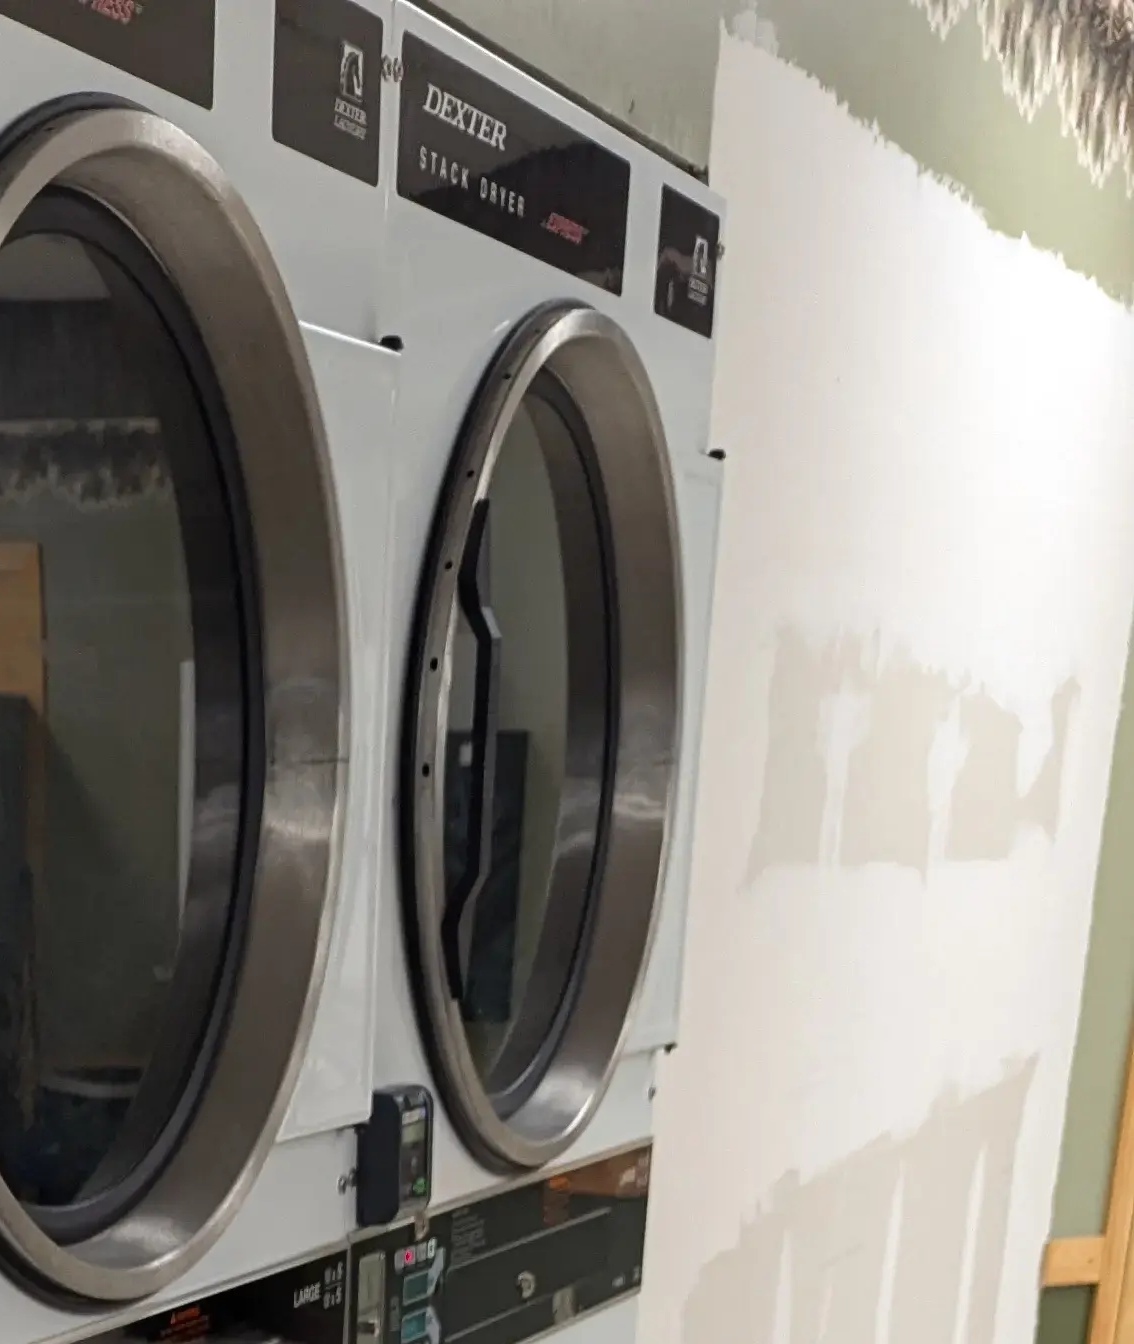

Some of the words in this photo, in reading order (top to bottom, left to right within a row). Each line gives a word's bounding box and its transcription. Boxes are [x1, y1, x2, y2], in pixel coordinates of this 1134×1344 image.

[422, 82, 507, 151] DEXTER
[419, 146, 470, 190] STACK
[479, 176, 525, 218] DRYER
